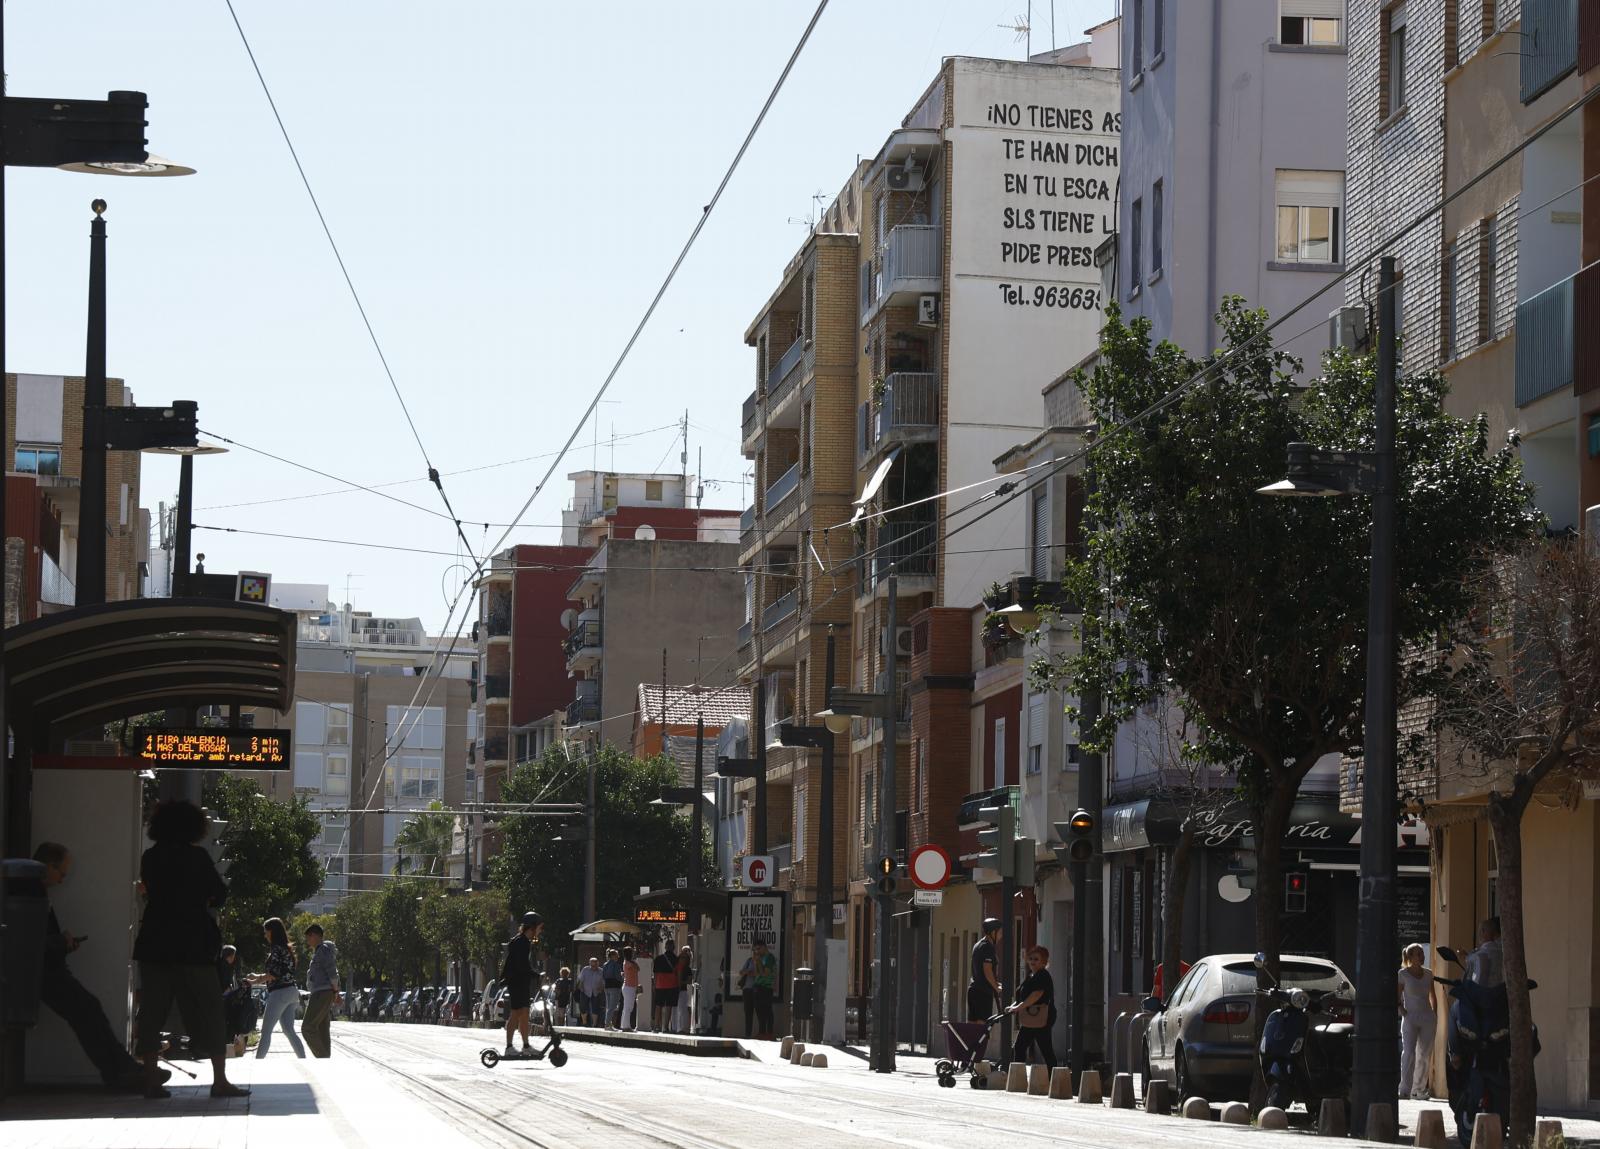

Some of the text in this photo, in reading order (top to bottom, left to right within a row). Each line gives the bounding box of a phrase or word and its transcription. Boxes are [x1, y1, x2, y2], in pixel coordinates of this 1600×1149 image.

[1027, 105, 1094, 131] TIENES
[1002, 138, 1118, 167] TE HAN DICH
[1004, 173, 1110, 201] EN TU ESCA
[1003, 207, 1036, 230] SLS
[1039, 210, 1095, 234] TIENE
[1001, 242, 1041, 264] PIDE
[146, 735, 279, 745] 4 FIRA VALENCIA 2 min
[146, 743, 279, 753] 4 MAS DEL ROSARI 9 min
[160, 752, 204, 761] circular
[208, 752, 225, 761] amb
[229, 753, 266, 762] retard.
[740, 903, 774, 917] LA MEJOR
[741, 917, 772, 931] CERVEZA
[737, 931, 777, 945] DEL MUNDO
